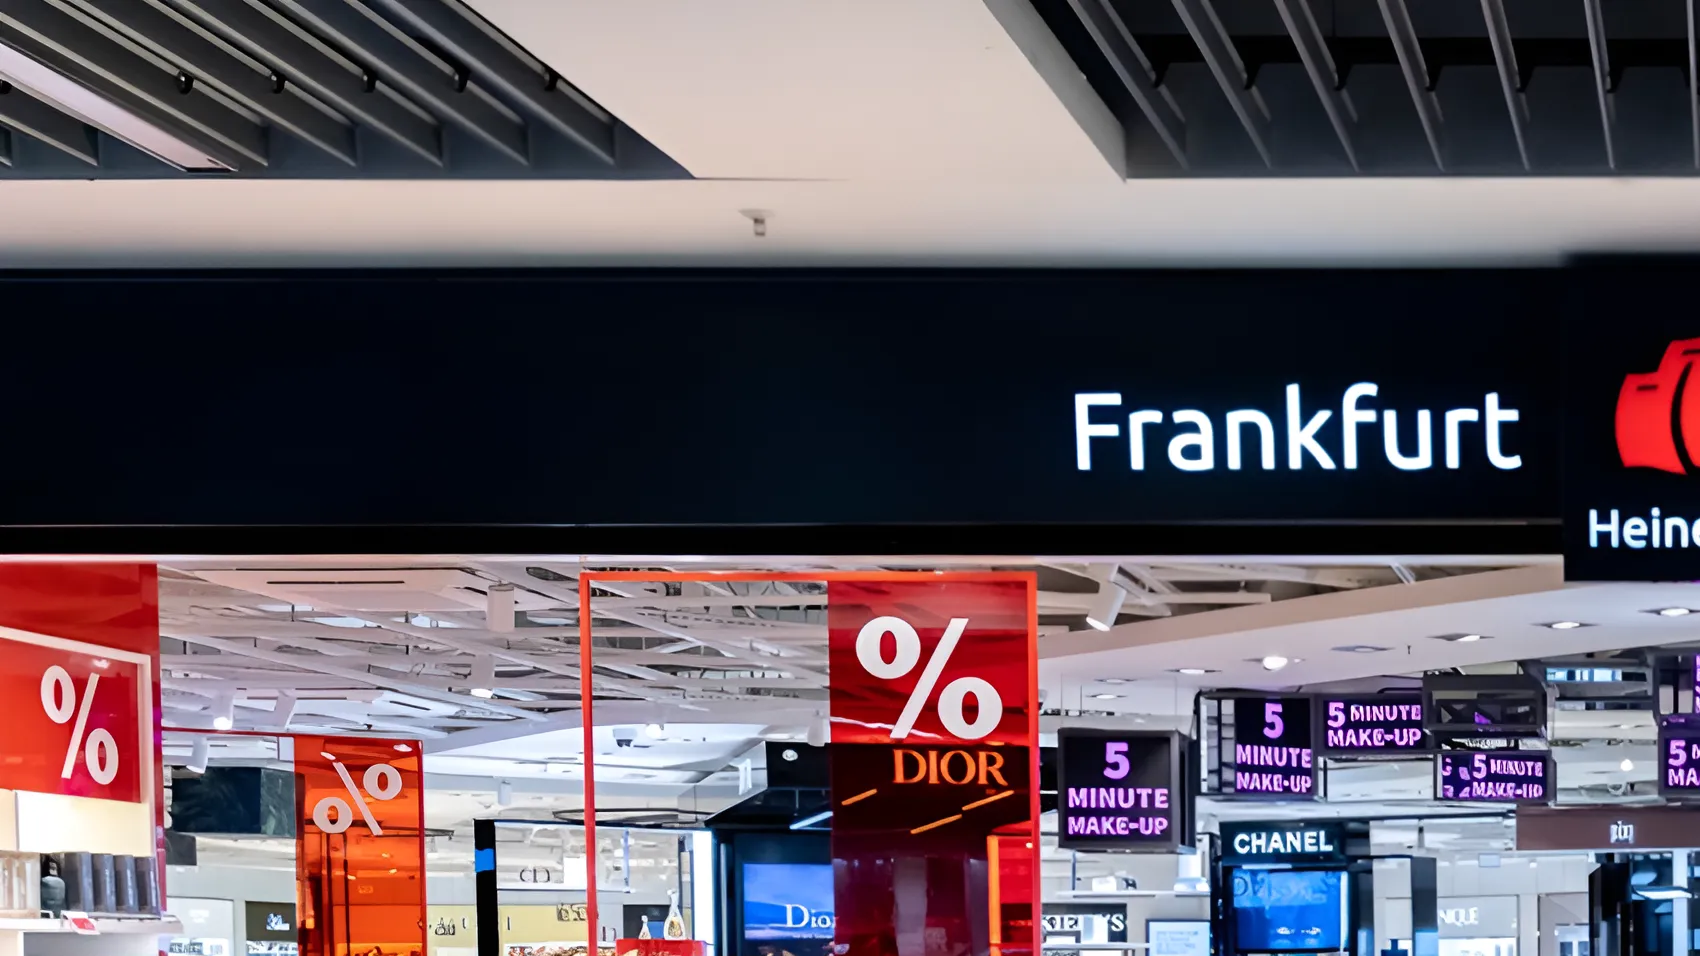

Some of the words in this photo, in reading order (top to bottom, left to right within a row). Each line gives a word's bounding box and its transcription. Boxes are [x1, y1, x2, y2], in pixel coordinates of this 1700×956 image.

[1074, 381, 1523, 471] Frankfurt
[855, 615, 1003, 740] %
[40, 664, 119, 785] %
[1263, 703, 1284, 738] 5
[1327, 701, 1345, 728] 5
[1350, 704, 1422, 722] MINUTE
[1327, 728, 1422, 746] MAKE-UP
[1103, 742, 1130, 780] 5
[1236, 744, 1312, 769] MINUTE
[1472, 753, 1488, 780] 5
[1667, 739, 1687, 767] 5
[892, 749, 1008, 786] DIOR
[1236, 772, 1312, 793] MAKE-UP
[1067, 787, 1169, 810] MINUTE
[1067, 816, 1169, 836] MAKE-UP
[1233, 829, 1334, 855] CHANEL
